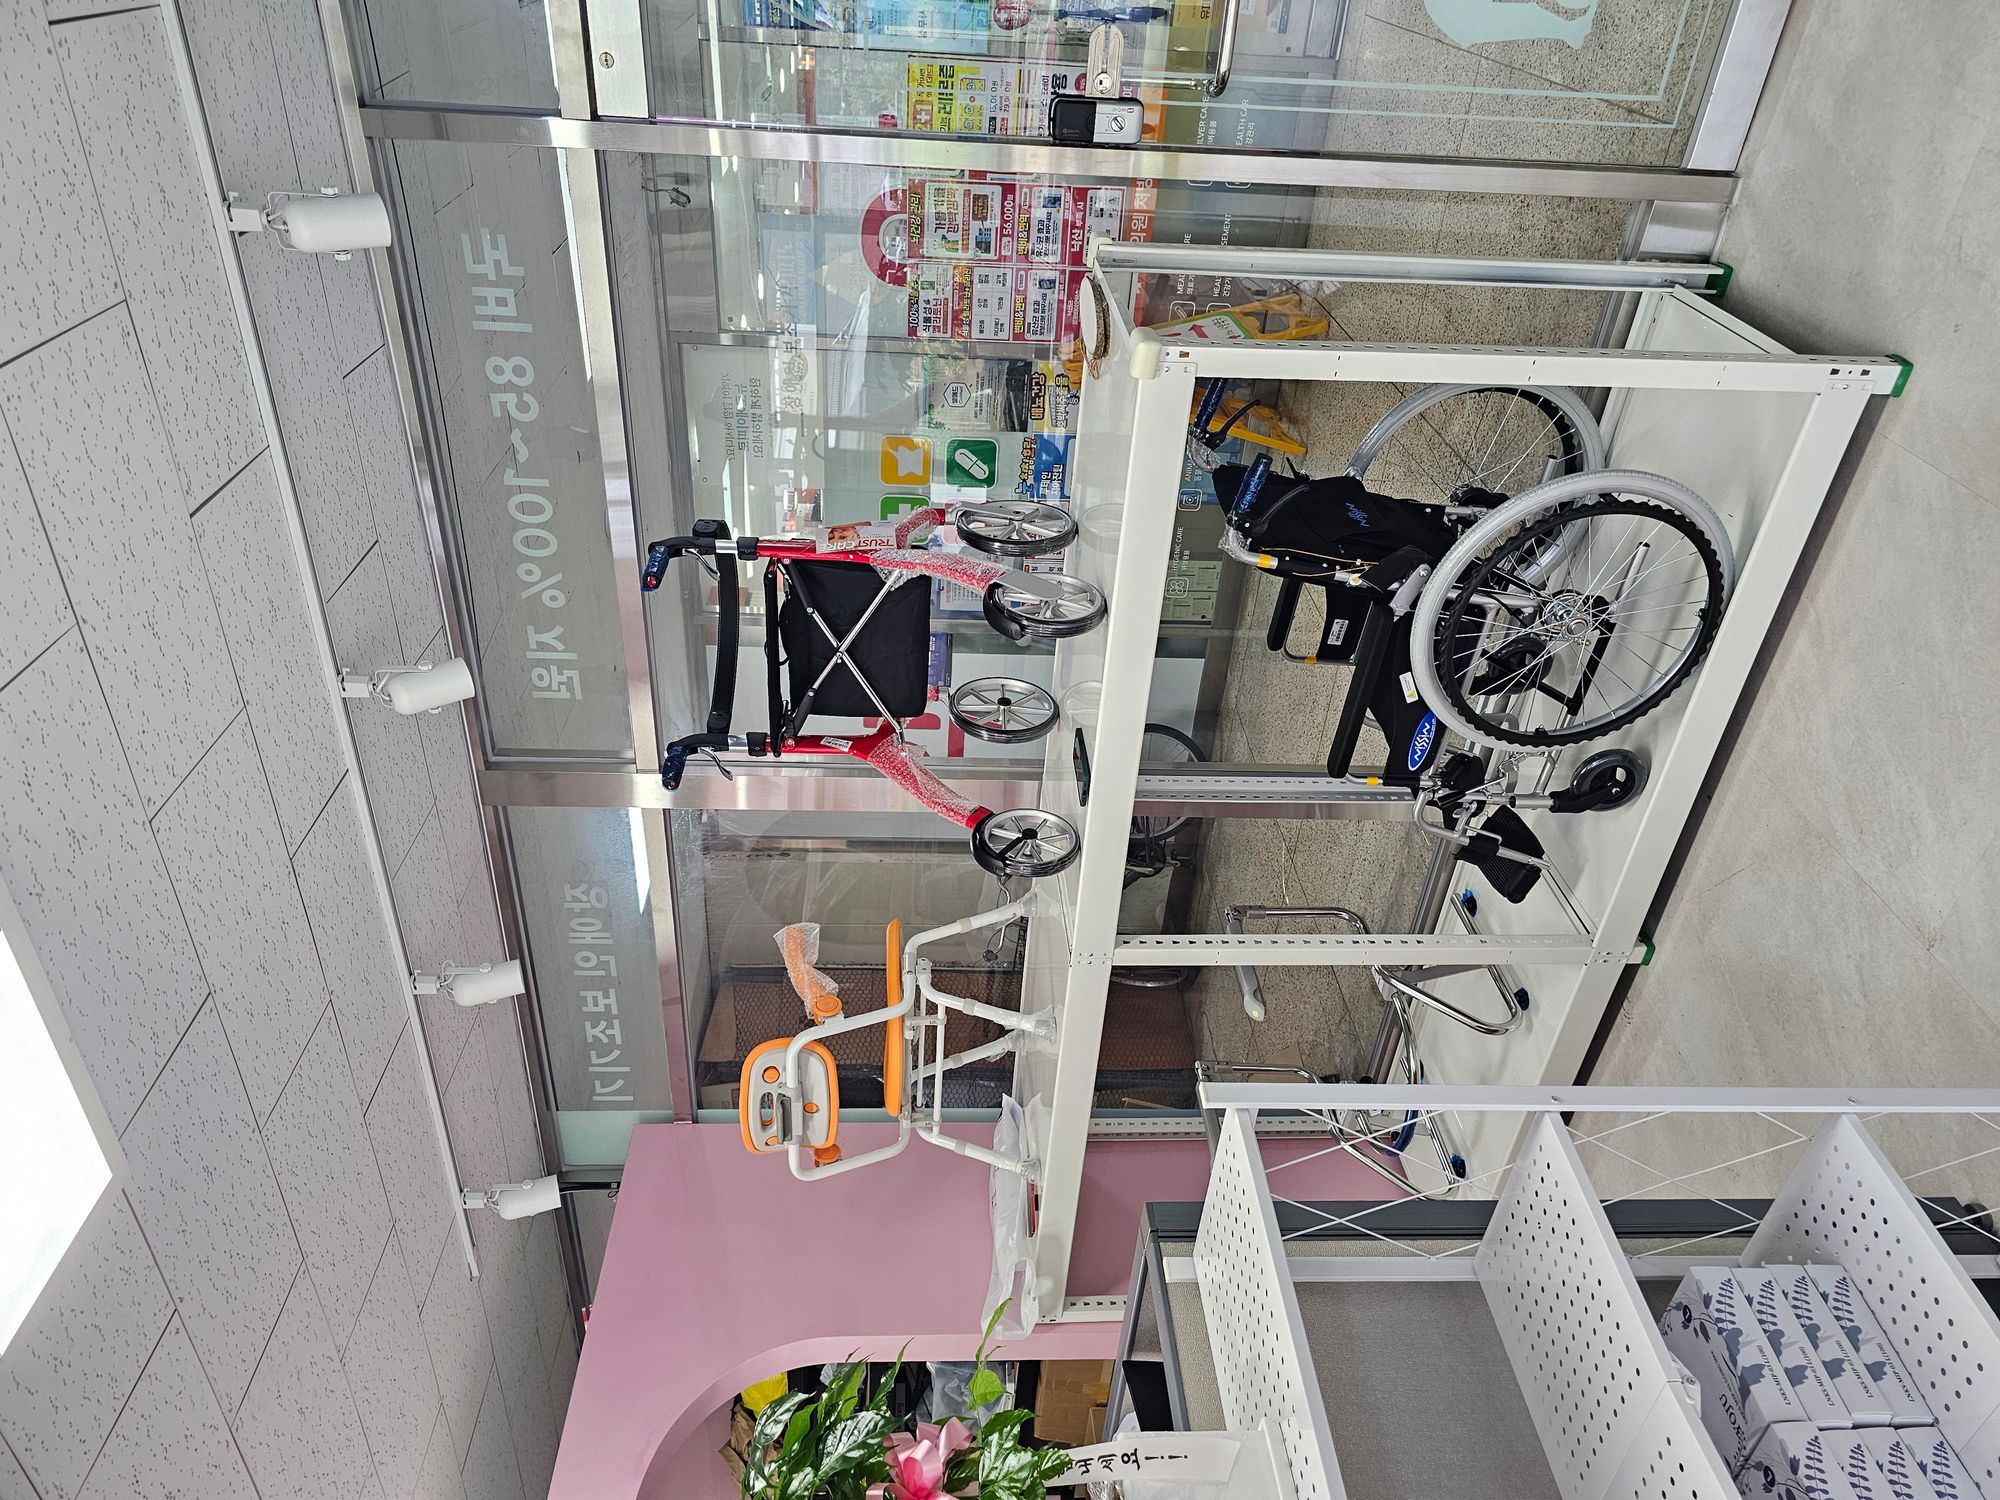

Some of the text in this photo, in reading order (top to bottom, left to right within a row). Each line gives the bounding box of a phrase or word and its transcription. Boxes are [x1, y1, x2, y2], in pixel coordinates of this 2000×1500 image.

[1200, 96, 1210, 119] CAE
[1003, 194, 1014, 235] 56,000원
[1071, 228, 1083, 251] 낙산
[922, 306, 932, 333] 식물성
[1040, 471, 1051, 496] 루테인
[855, 539, 894, 548] TRUST
[1171, 526, 1183, 571] HYGIENIC CARE
